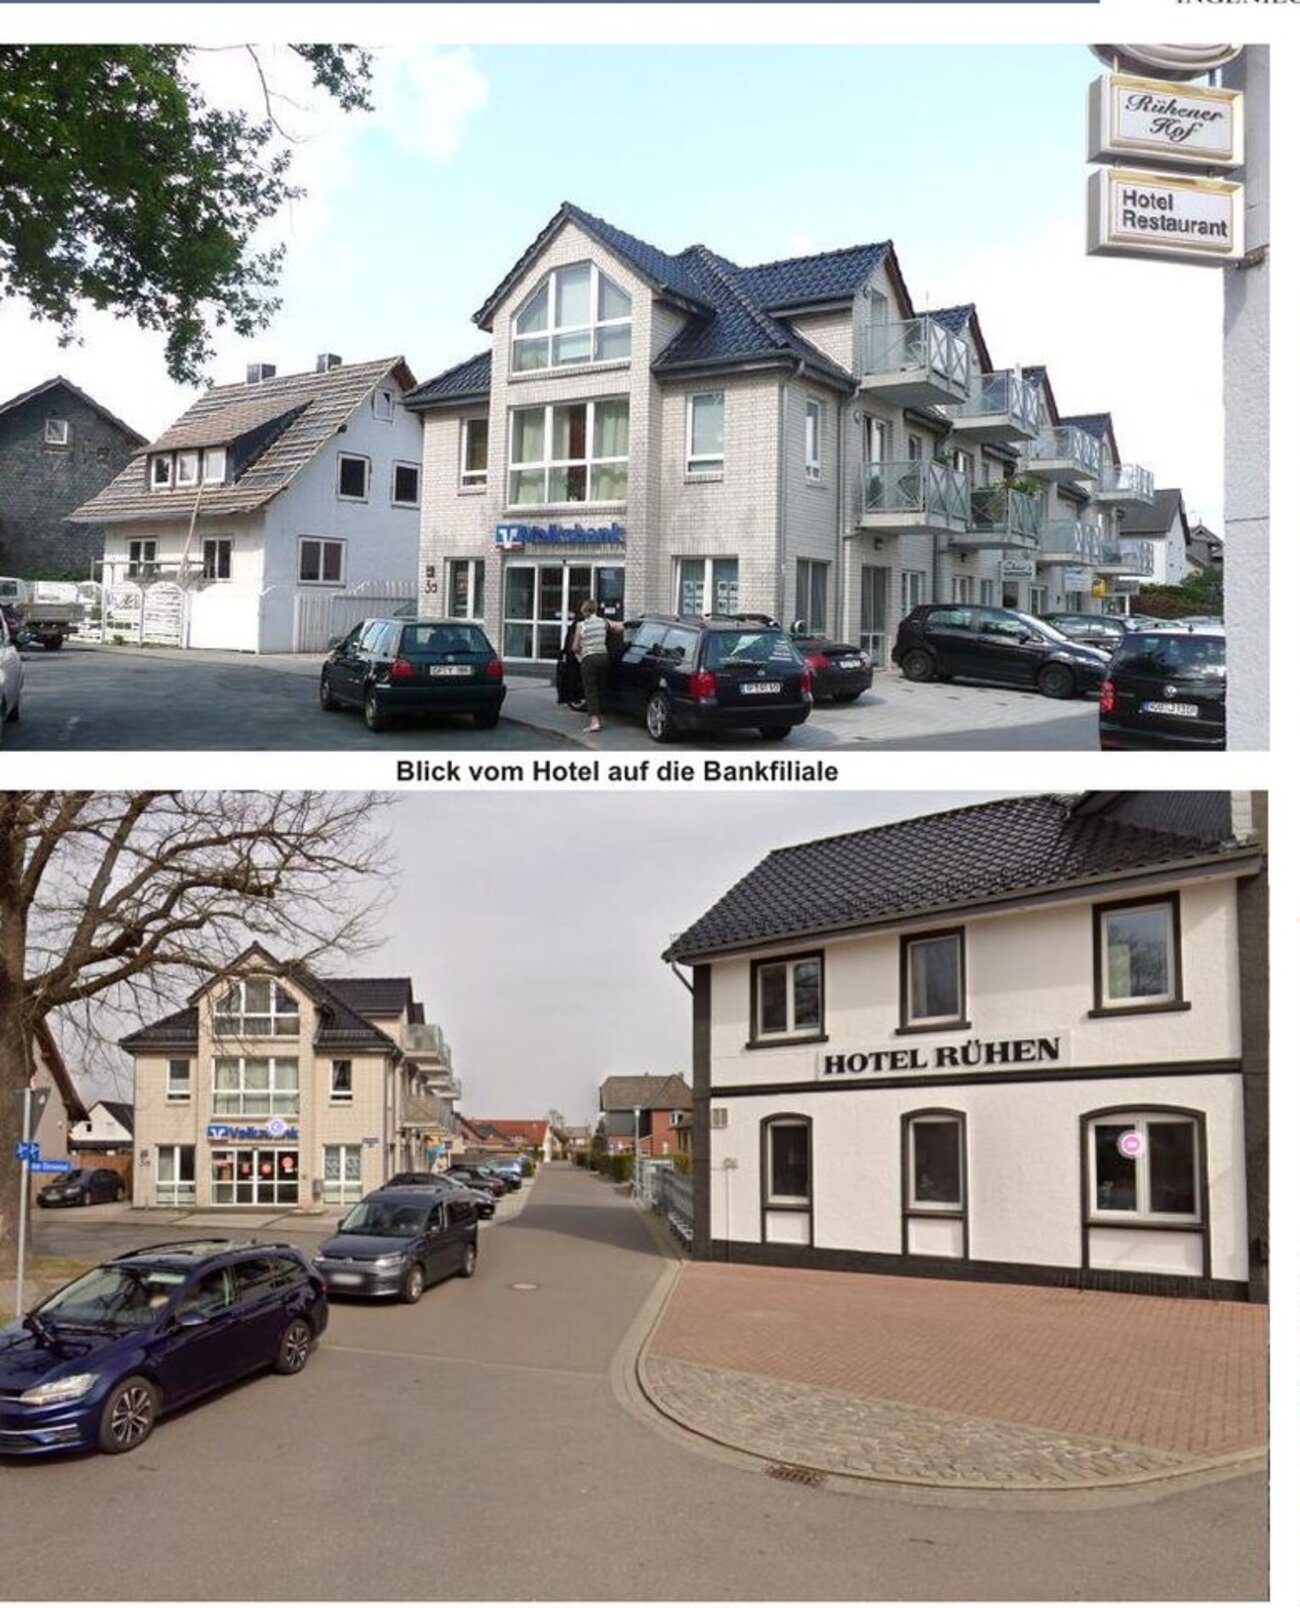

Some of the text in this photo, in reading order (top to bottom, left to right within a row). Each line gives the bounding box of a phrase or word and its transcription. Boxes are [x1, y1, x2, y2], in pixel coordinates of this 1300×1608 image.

[1125, 94, 1223, 122] Rühener
[1149, 117, 1203, 142] Hof
[1122, 189, 1173, 212] Hotel
[1122, 209, 1228, 238] Restaurant
[824, 1037, 1061, 1075] HOTEL RÜHEN
